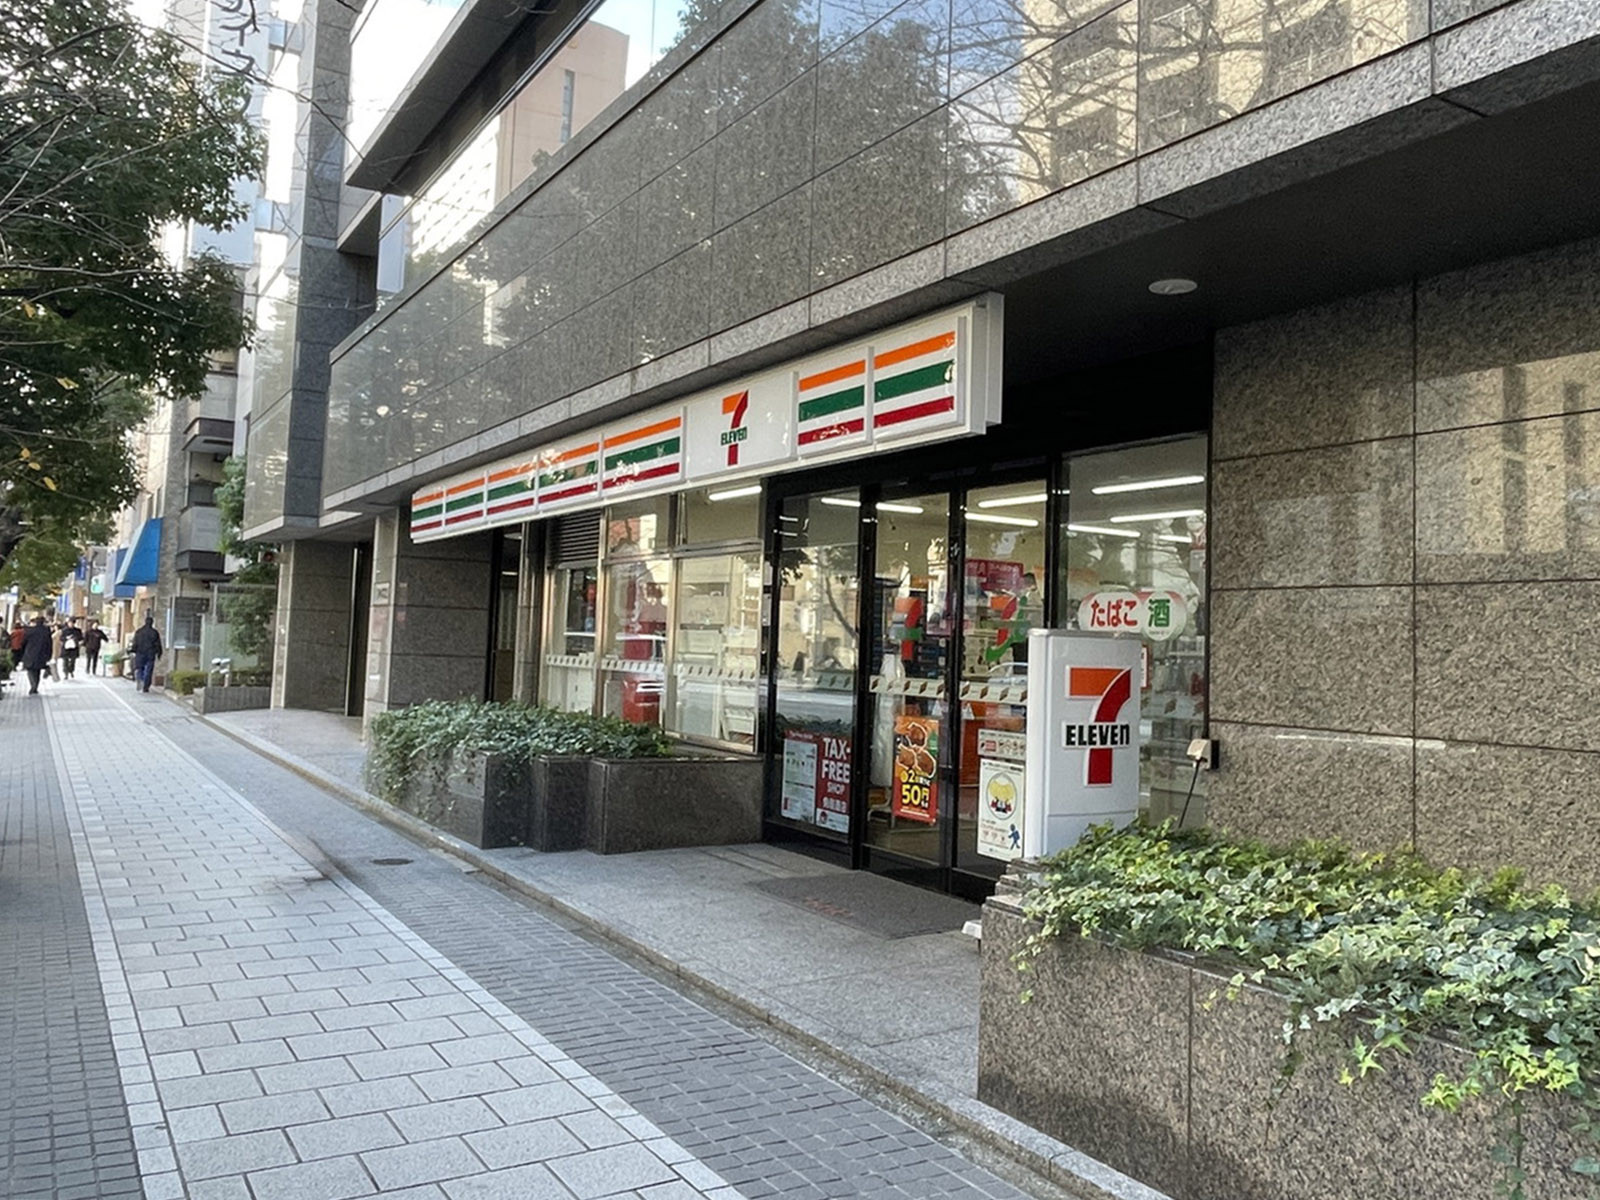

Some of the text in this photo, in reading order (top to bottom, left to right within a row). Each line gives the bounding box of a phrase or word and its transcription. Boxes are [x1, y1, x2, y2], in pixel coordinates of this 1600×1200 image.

[722, 389, 748, 465] 7
[1091, 599, 1170, 627] たばこ 酒
[1069, 666, 1131, 785] 7
[823, 737, 851, 760] TAX-
[821, 759, 850, 783] FREE
